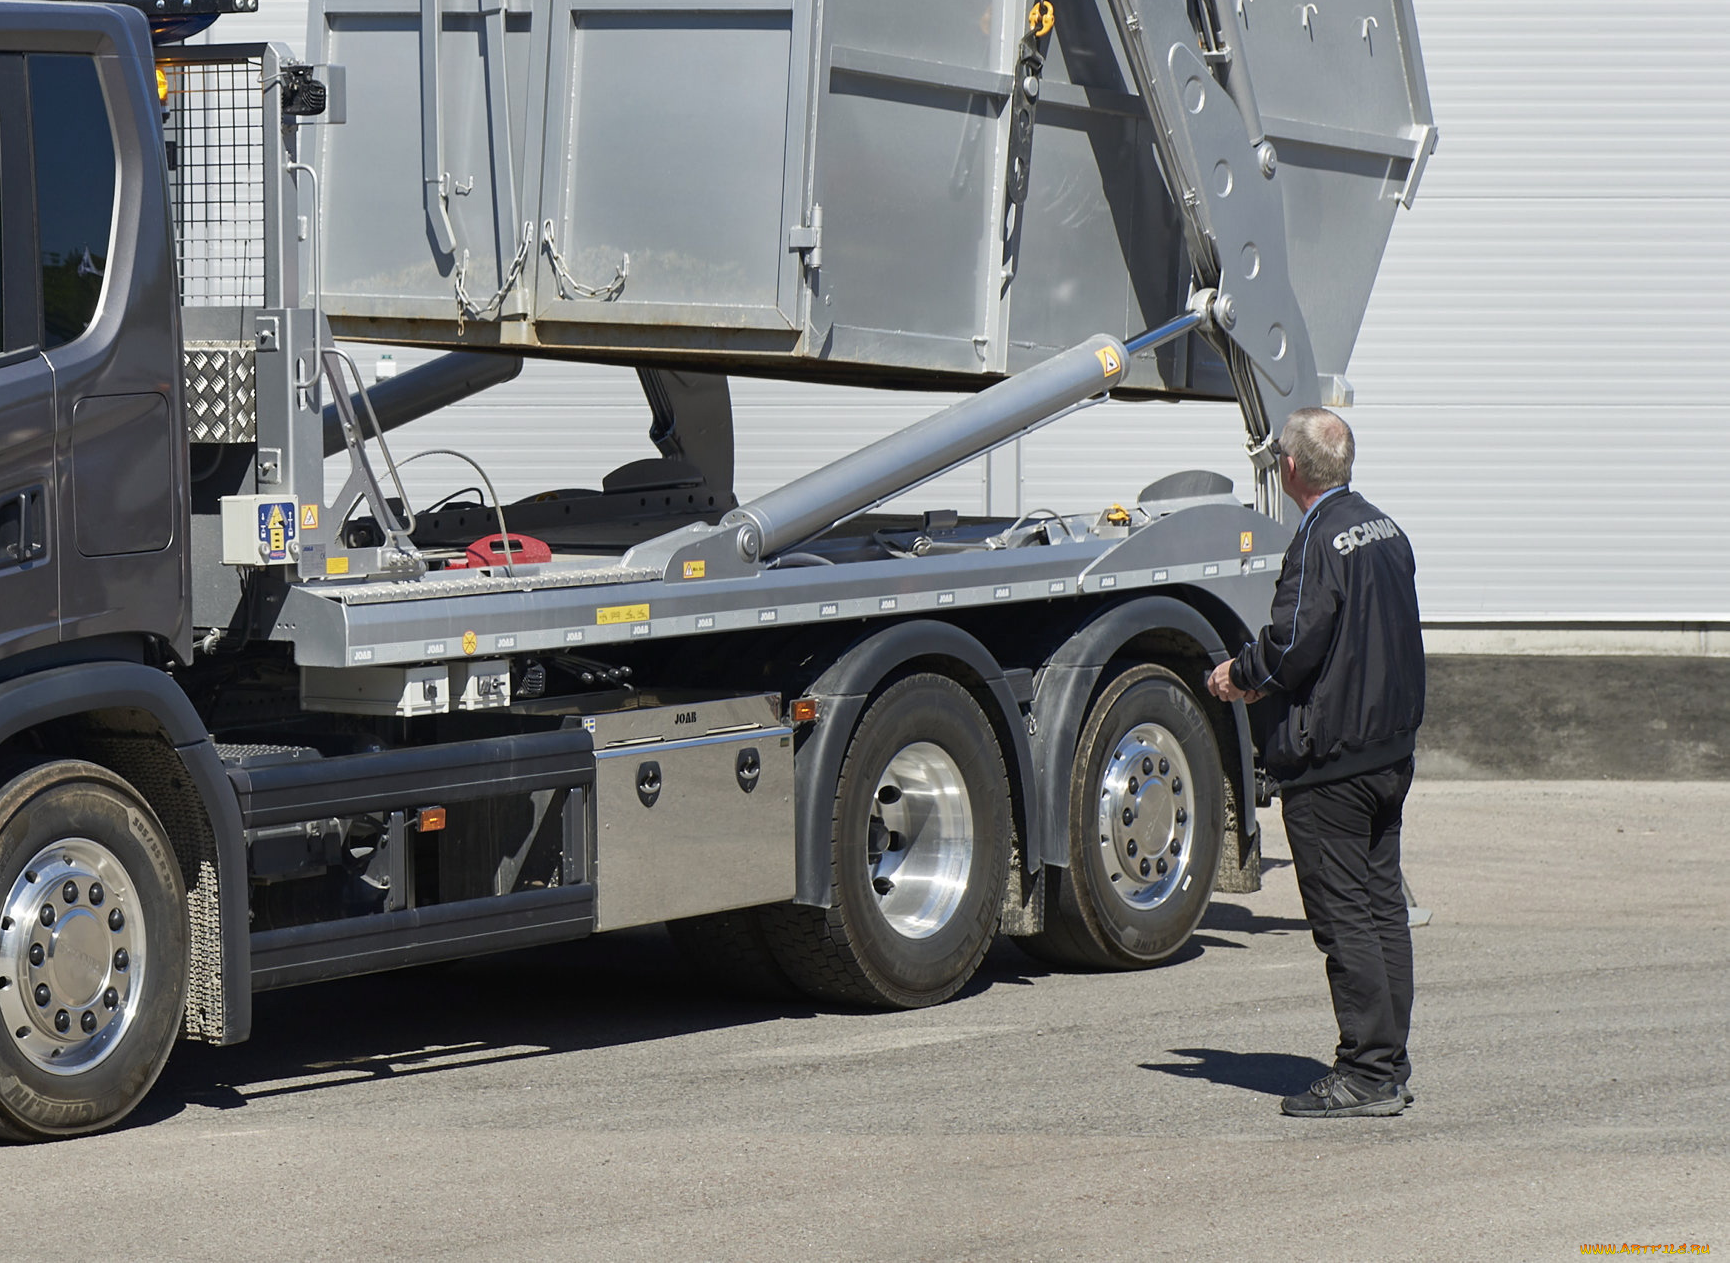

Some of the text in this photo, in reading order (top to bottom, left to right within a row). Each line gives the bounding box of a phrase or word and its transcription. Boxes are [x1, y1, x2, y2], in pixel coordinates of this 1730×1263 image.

[1333, 517, 1400, 555] SCANIA
[760, 611, 776, 621] JOAB
[697, 618, 713, 628] JOAB
[632, 625, 649, 635] JOAB
[566, 631, 583, 642] JOAB
[497, 637, 515, 648] JOAB
[426, 644, 445, 655] JOAB
[354, 650, 372, 661] JOAB
[674, 711, 697, 725] JOAB
